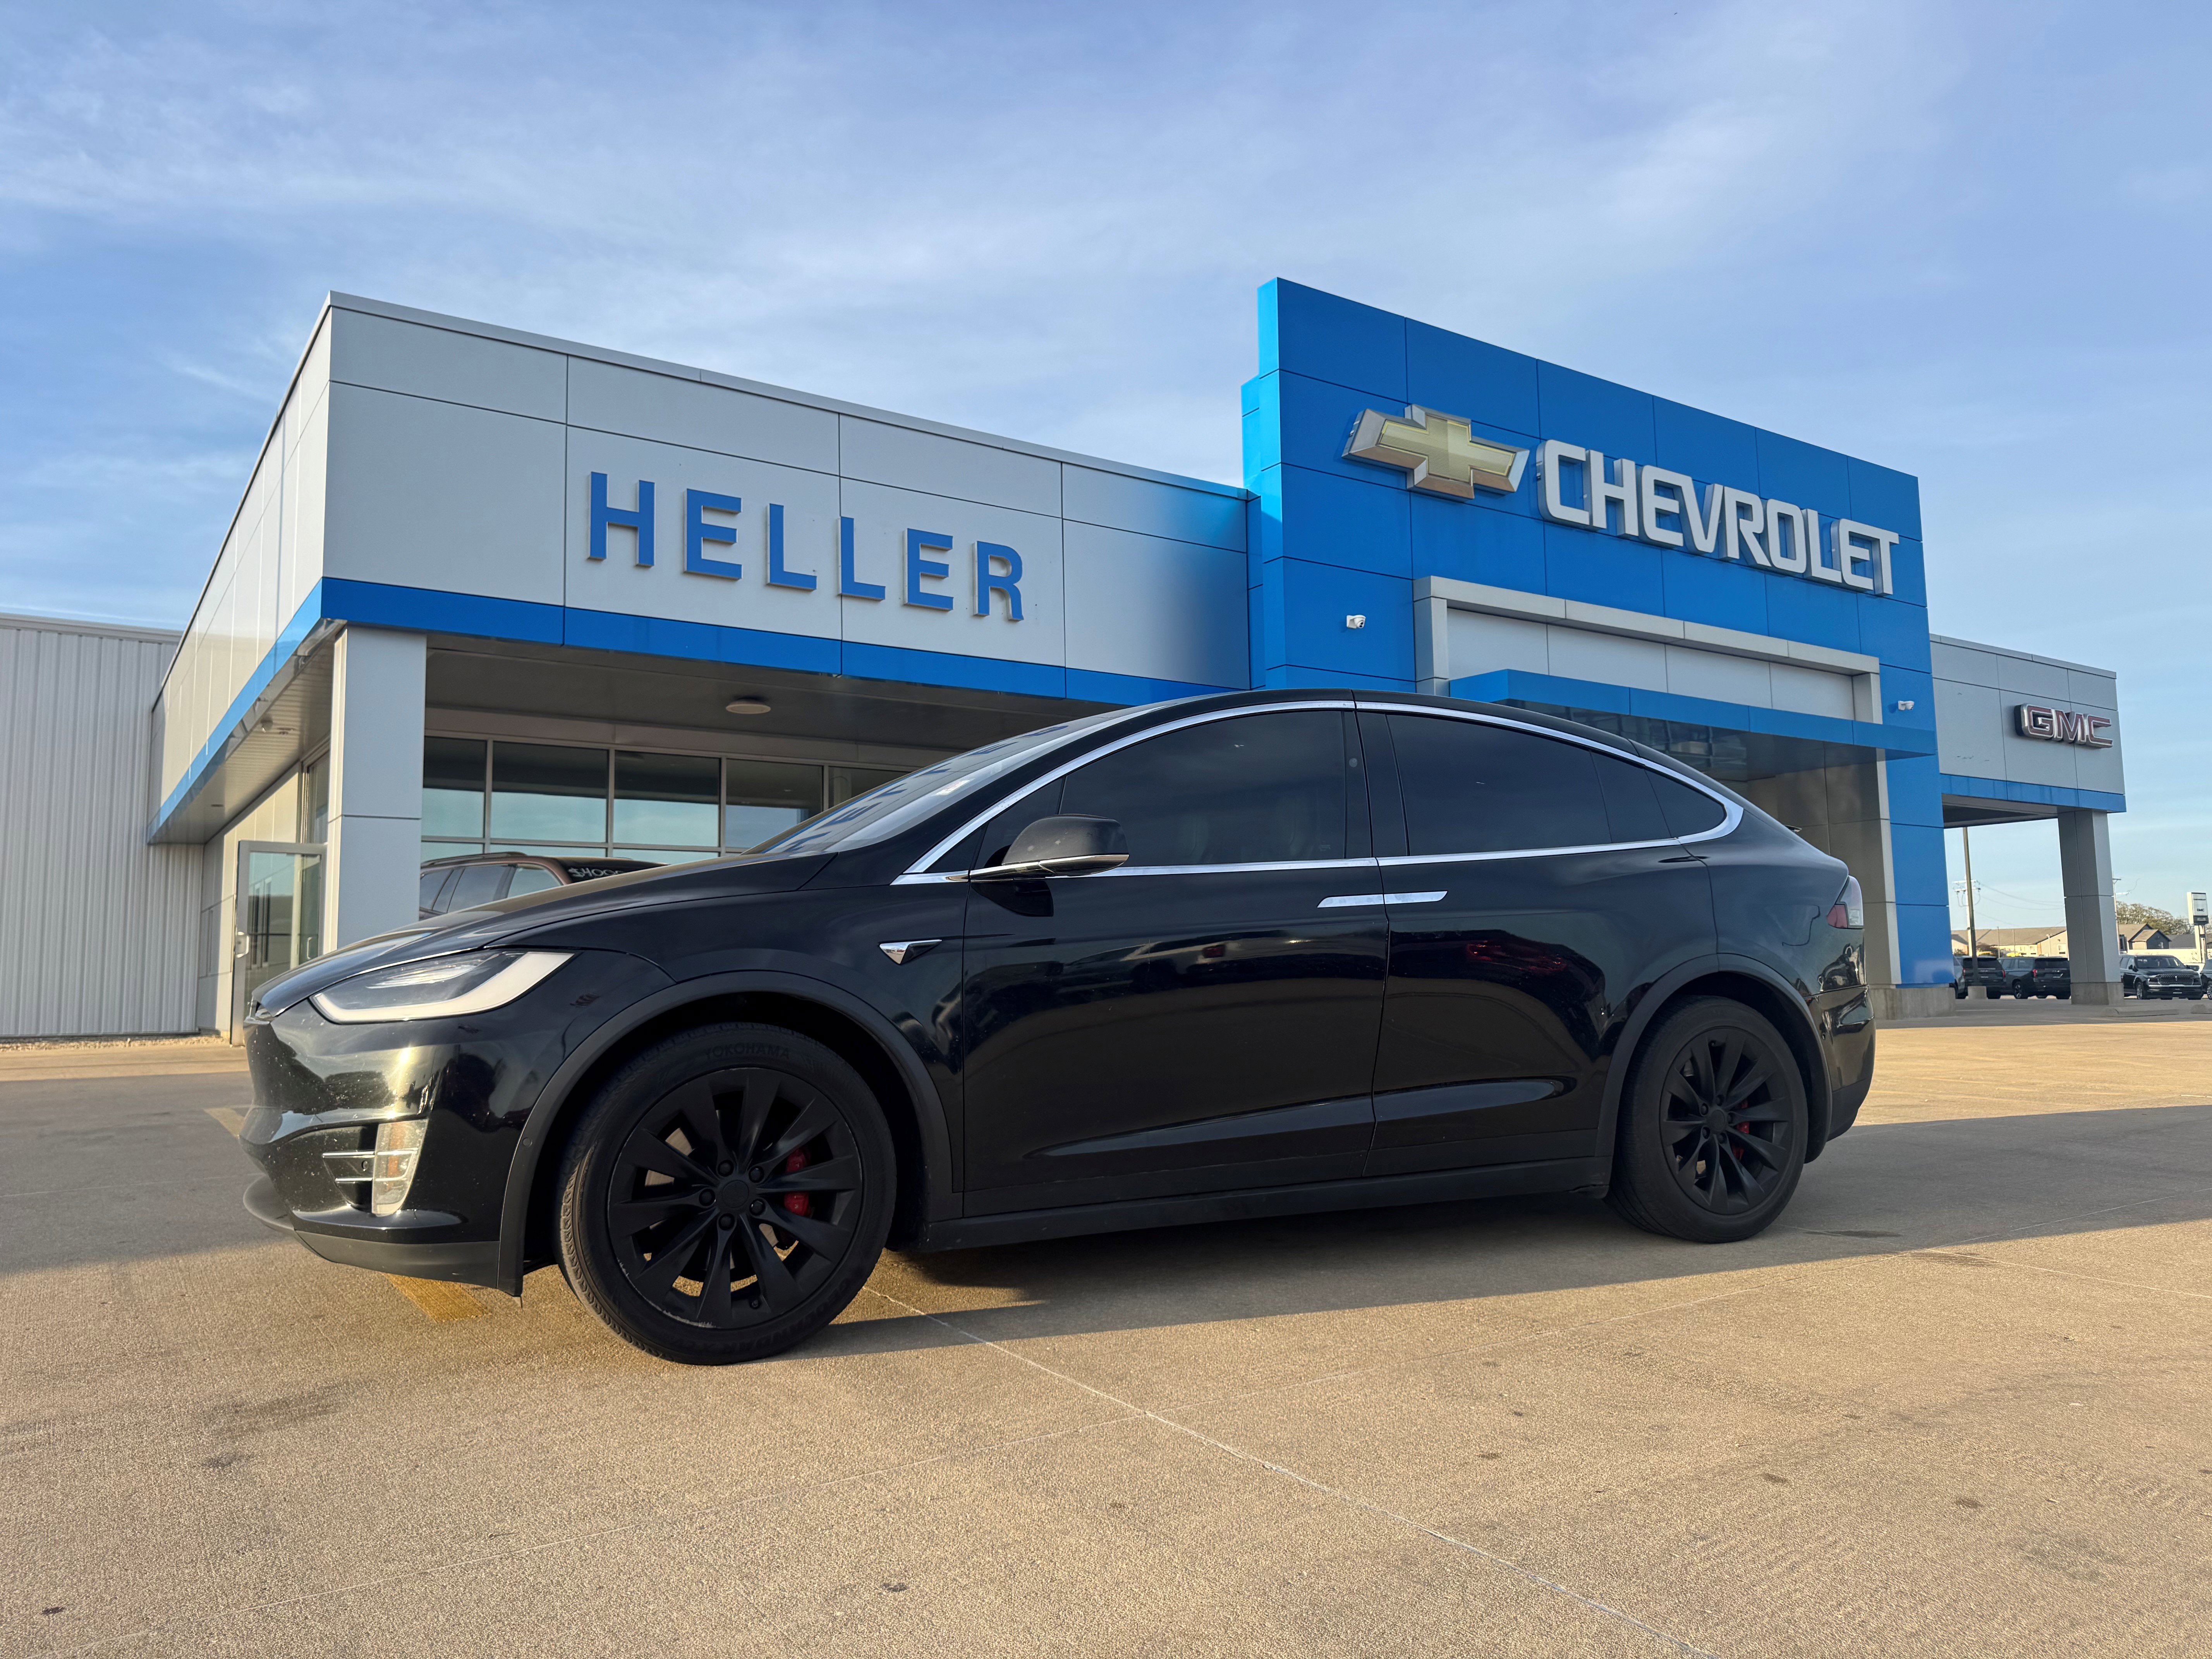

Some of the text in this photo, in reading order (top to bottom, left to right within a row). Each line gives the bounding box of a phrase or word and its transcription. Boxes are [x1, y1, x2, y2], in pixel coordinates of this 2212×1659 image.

[587, 471, 1024, 622] HELLER
[1536, 439, 1899, 596] CHEVROLET
[2014, 703, 2113, 748] GMC
[705, 1042, 790, 1060] YOKOHAMA
